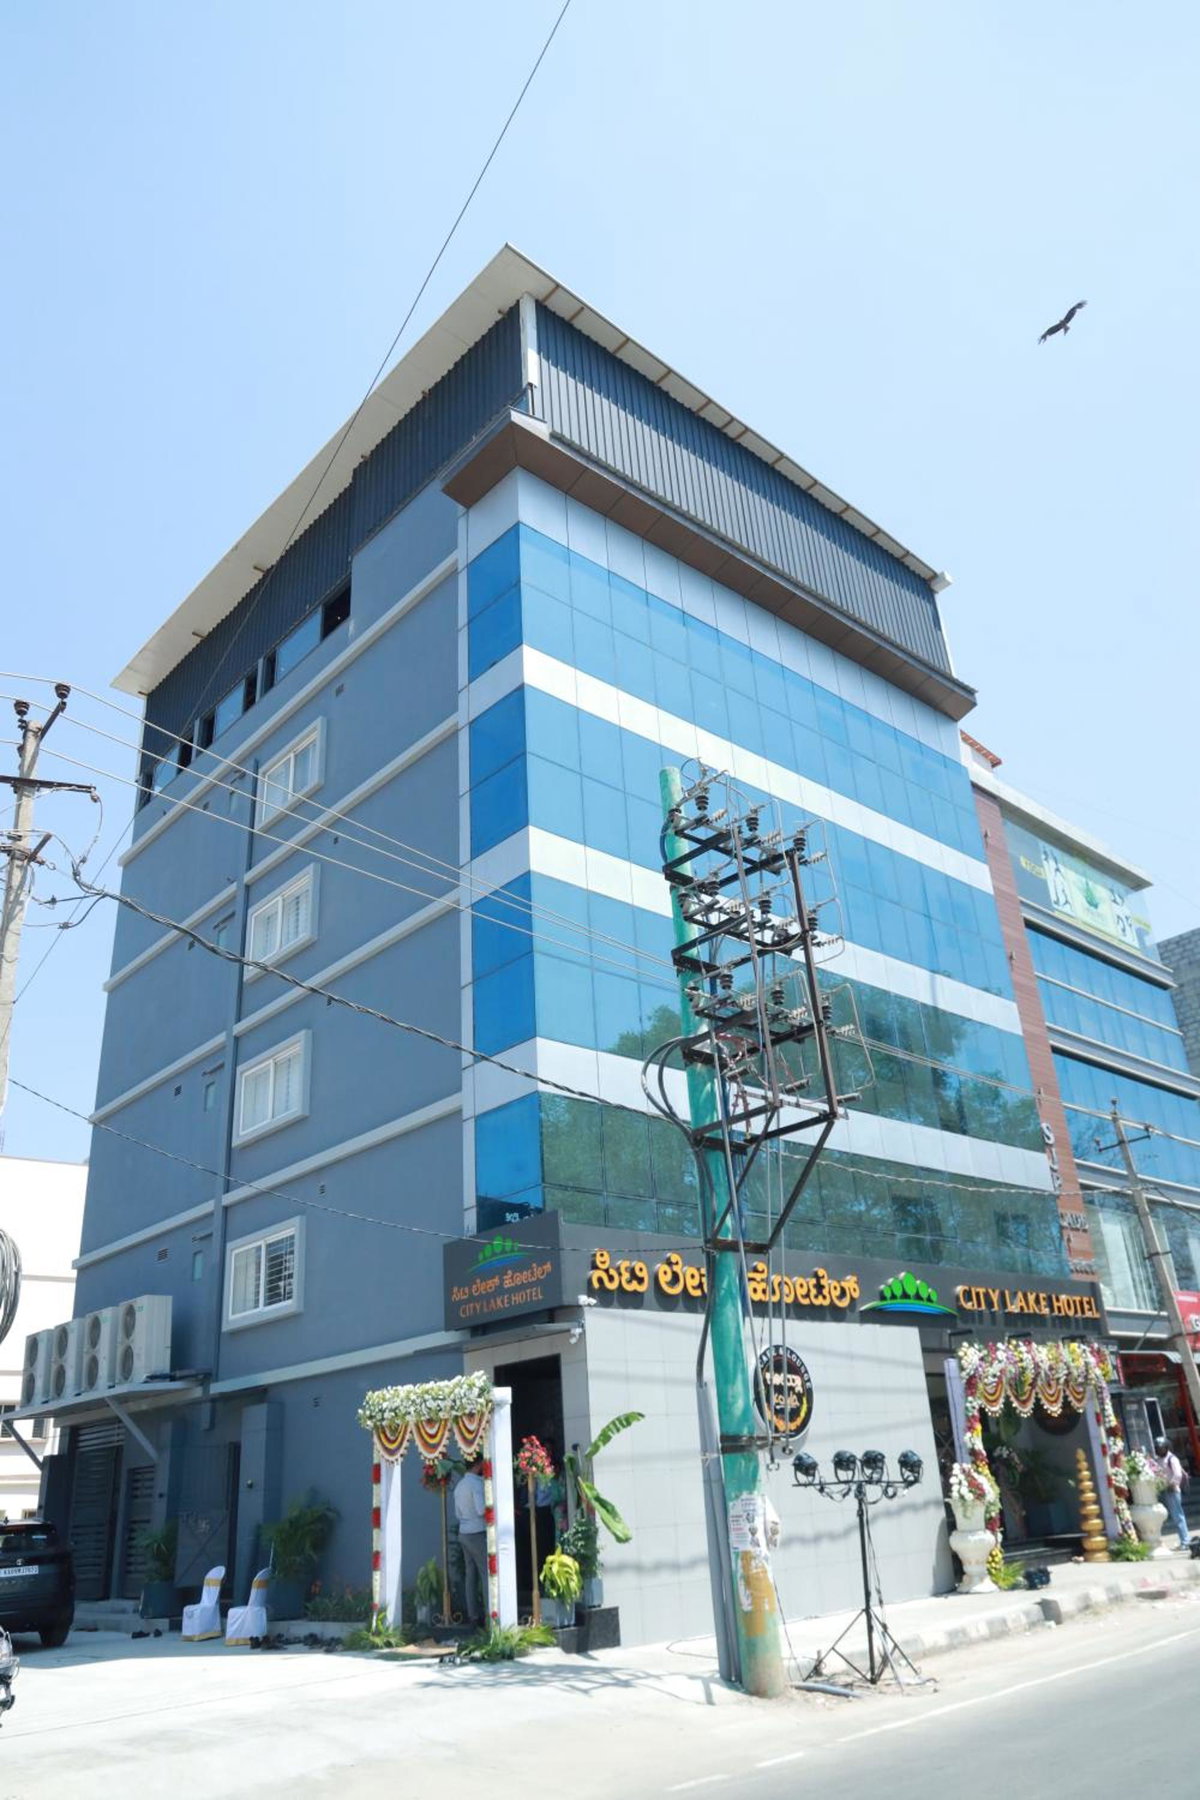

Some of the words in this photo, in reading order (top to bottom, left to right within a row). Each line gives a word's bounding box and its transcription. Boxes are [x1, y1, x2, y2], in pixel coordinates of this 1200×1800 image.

[451, 1285, 469, 1302] ಸಿಟಿ
[588, 1248, 649, 1293] ಸಿಟಿ
[656, 1250, 708, 1297] ಲೇ
[747, 1260, 860, 1308] ಹೋಟೆಲ್
[460, 1301, 481, 1318] CITY
[483, 1293, 511, 1313] LAKE
[511, 1285, 544, 1306] HOTEL
[955, 1284, 1000, 1312] CITY
[1004, 1289, 1050, 1314] LAKE
[1051, 1293, 1101, 1319] HOTEL
